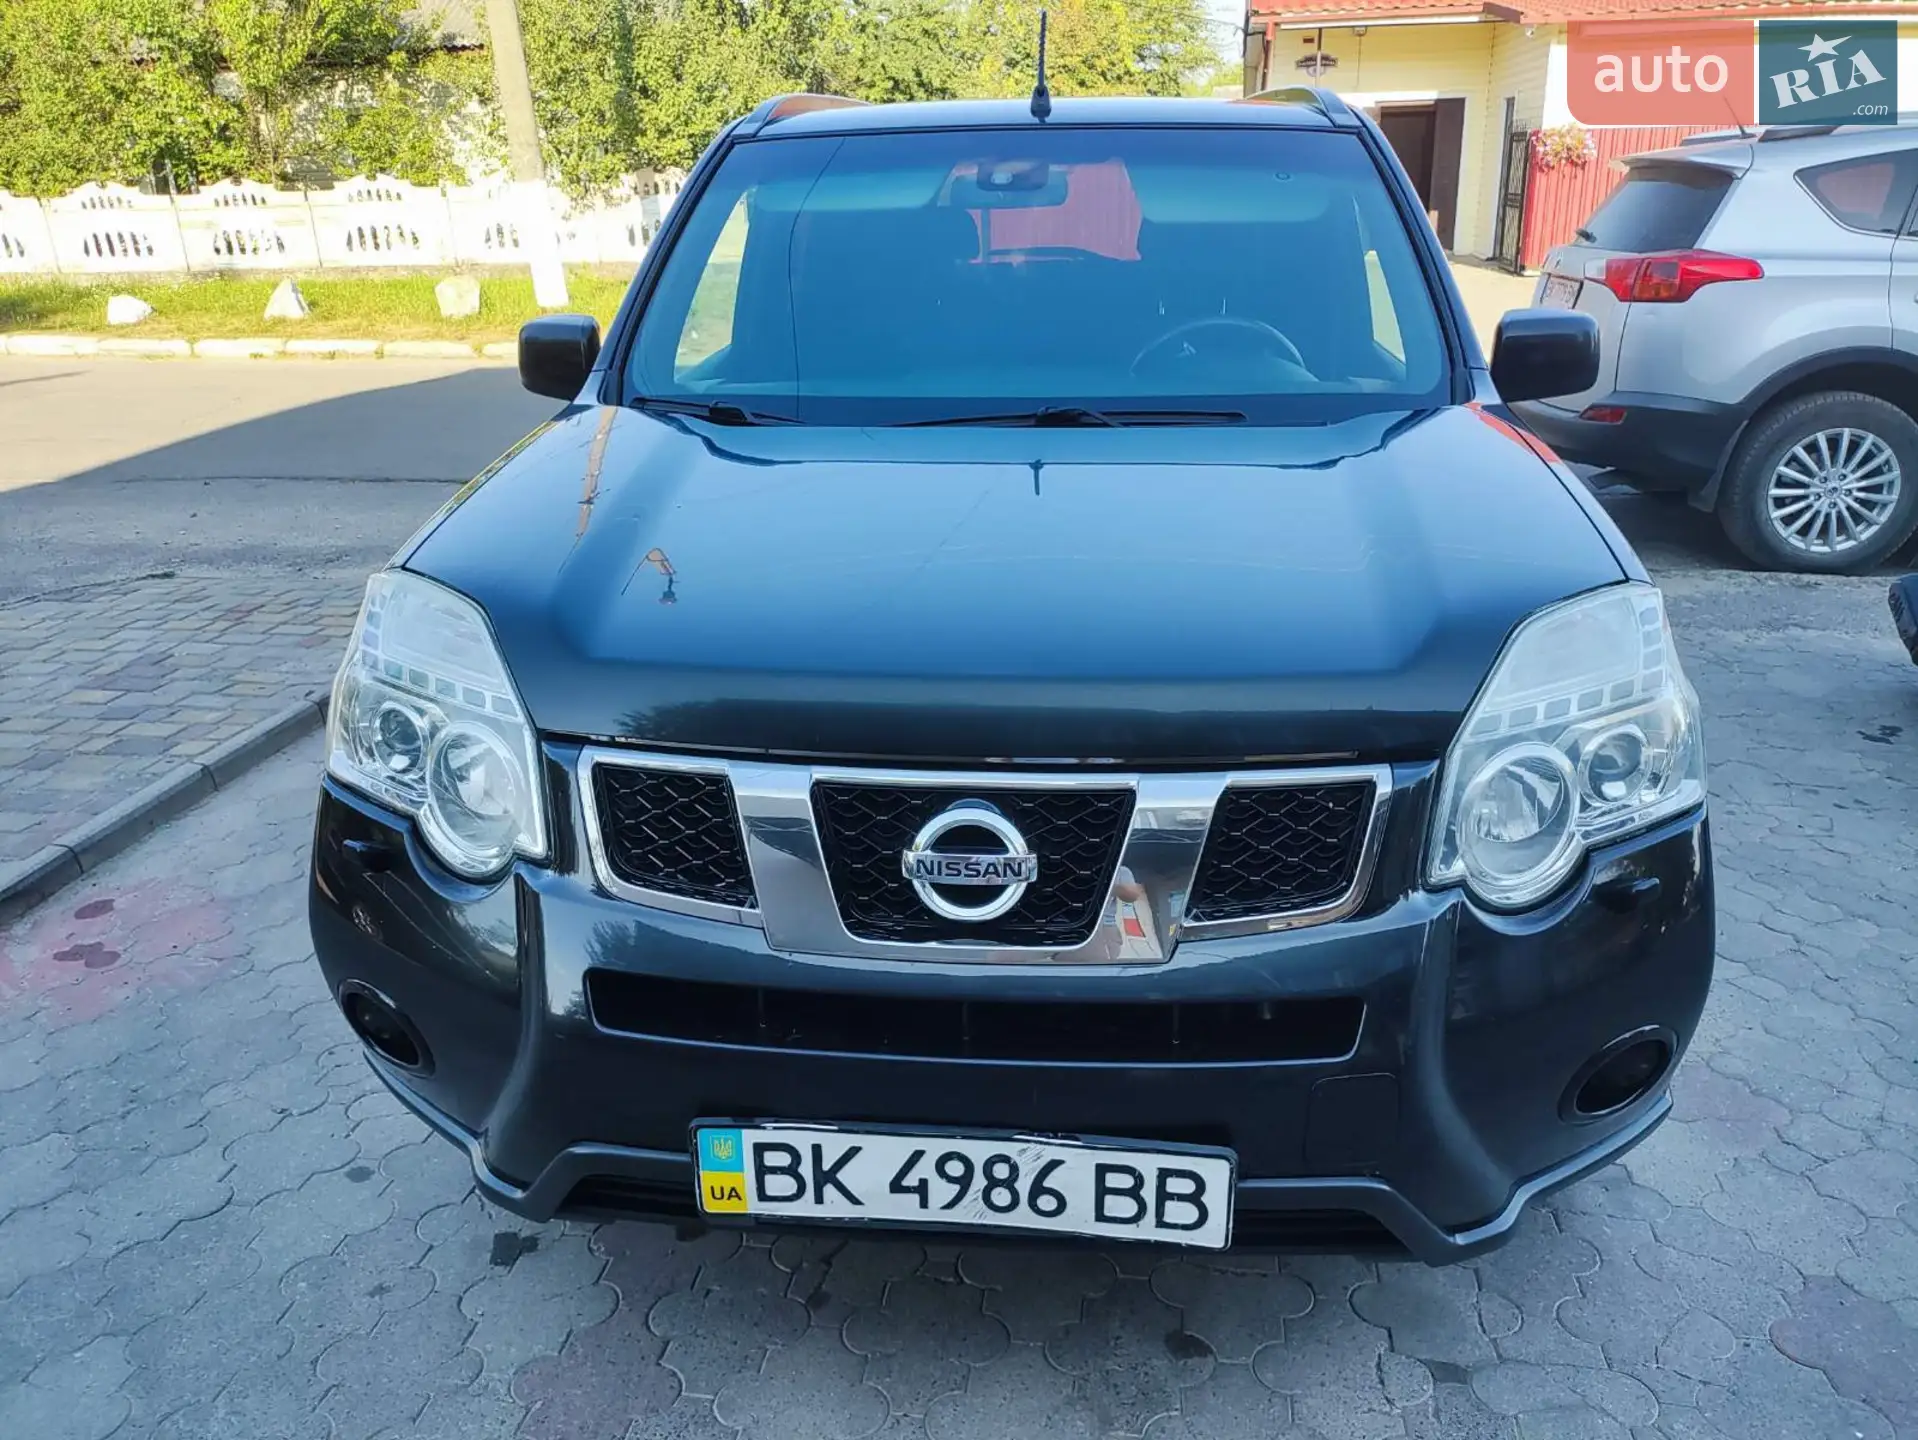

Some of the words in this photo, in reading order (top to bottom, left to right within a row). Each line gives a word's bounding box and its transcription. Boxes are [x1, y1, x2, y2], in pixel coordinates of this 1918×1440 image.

[916, 859, 1022, 878] NISSAN
[710, 1185, 742, 1201] UA
[752, 1142, 863, 1205] BK
[888, 1149, 1068, 1217] 4986
[1094, 1163, 1209, 1231] BB
